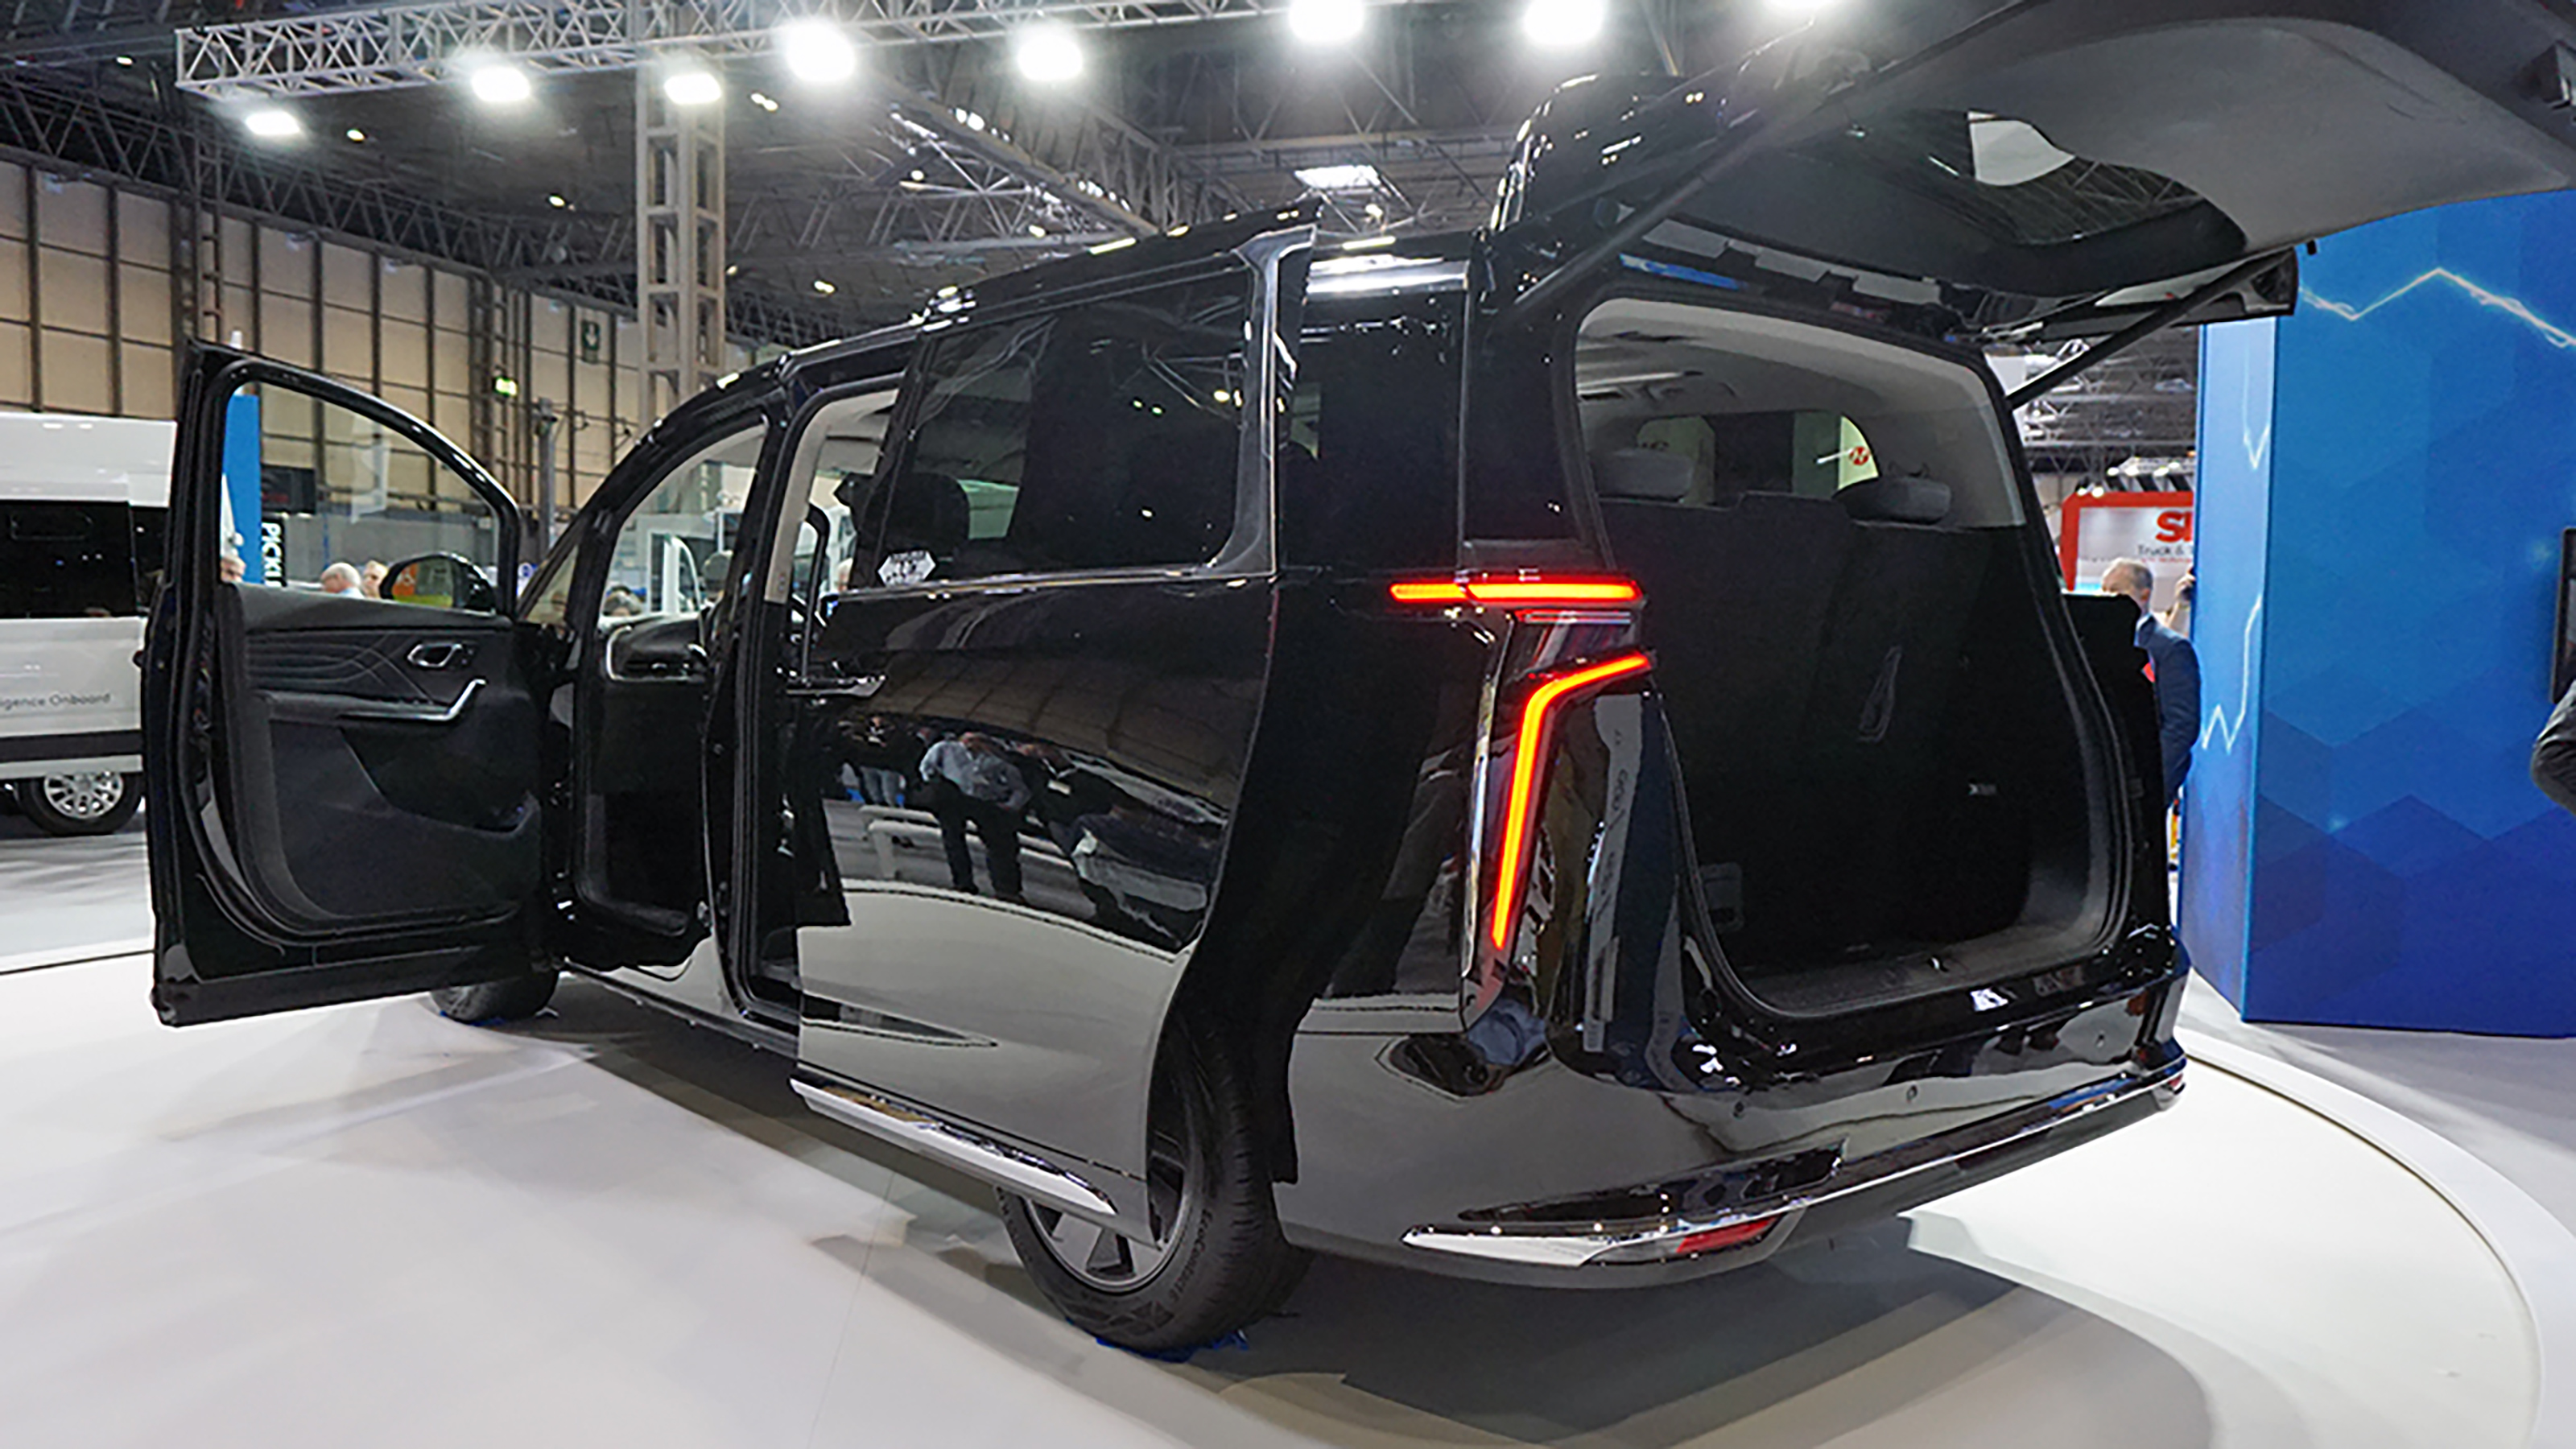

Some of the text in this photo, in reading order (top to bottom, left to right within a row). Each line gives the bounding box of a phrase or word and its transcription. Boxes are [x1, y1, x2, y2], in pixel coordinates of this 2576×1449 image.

[2138, 544, 2184, 556] Truck &
[49, 692, 111, 706] Onboard
